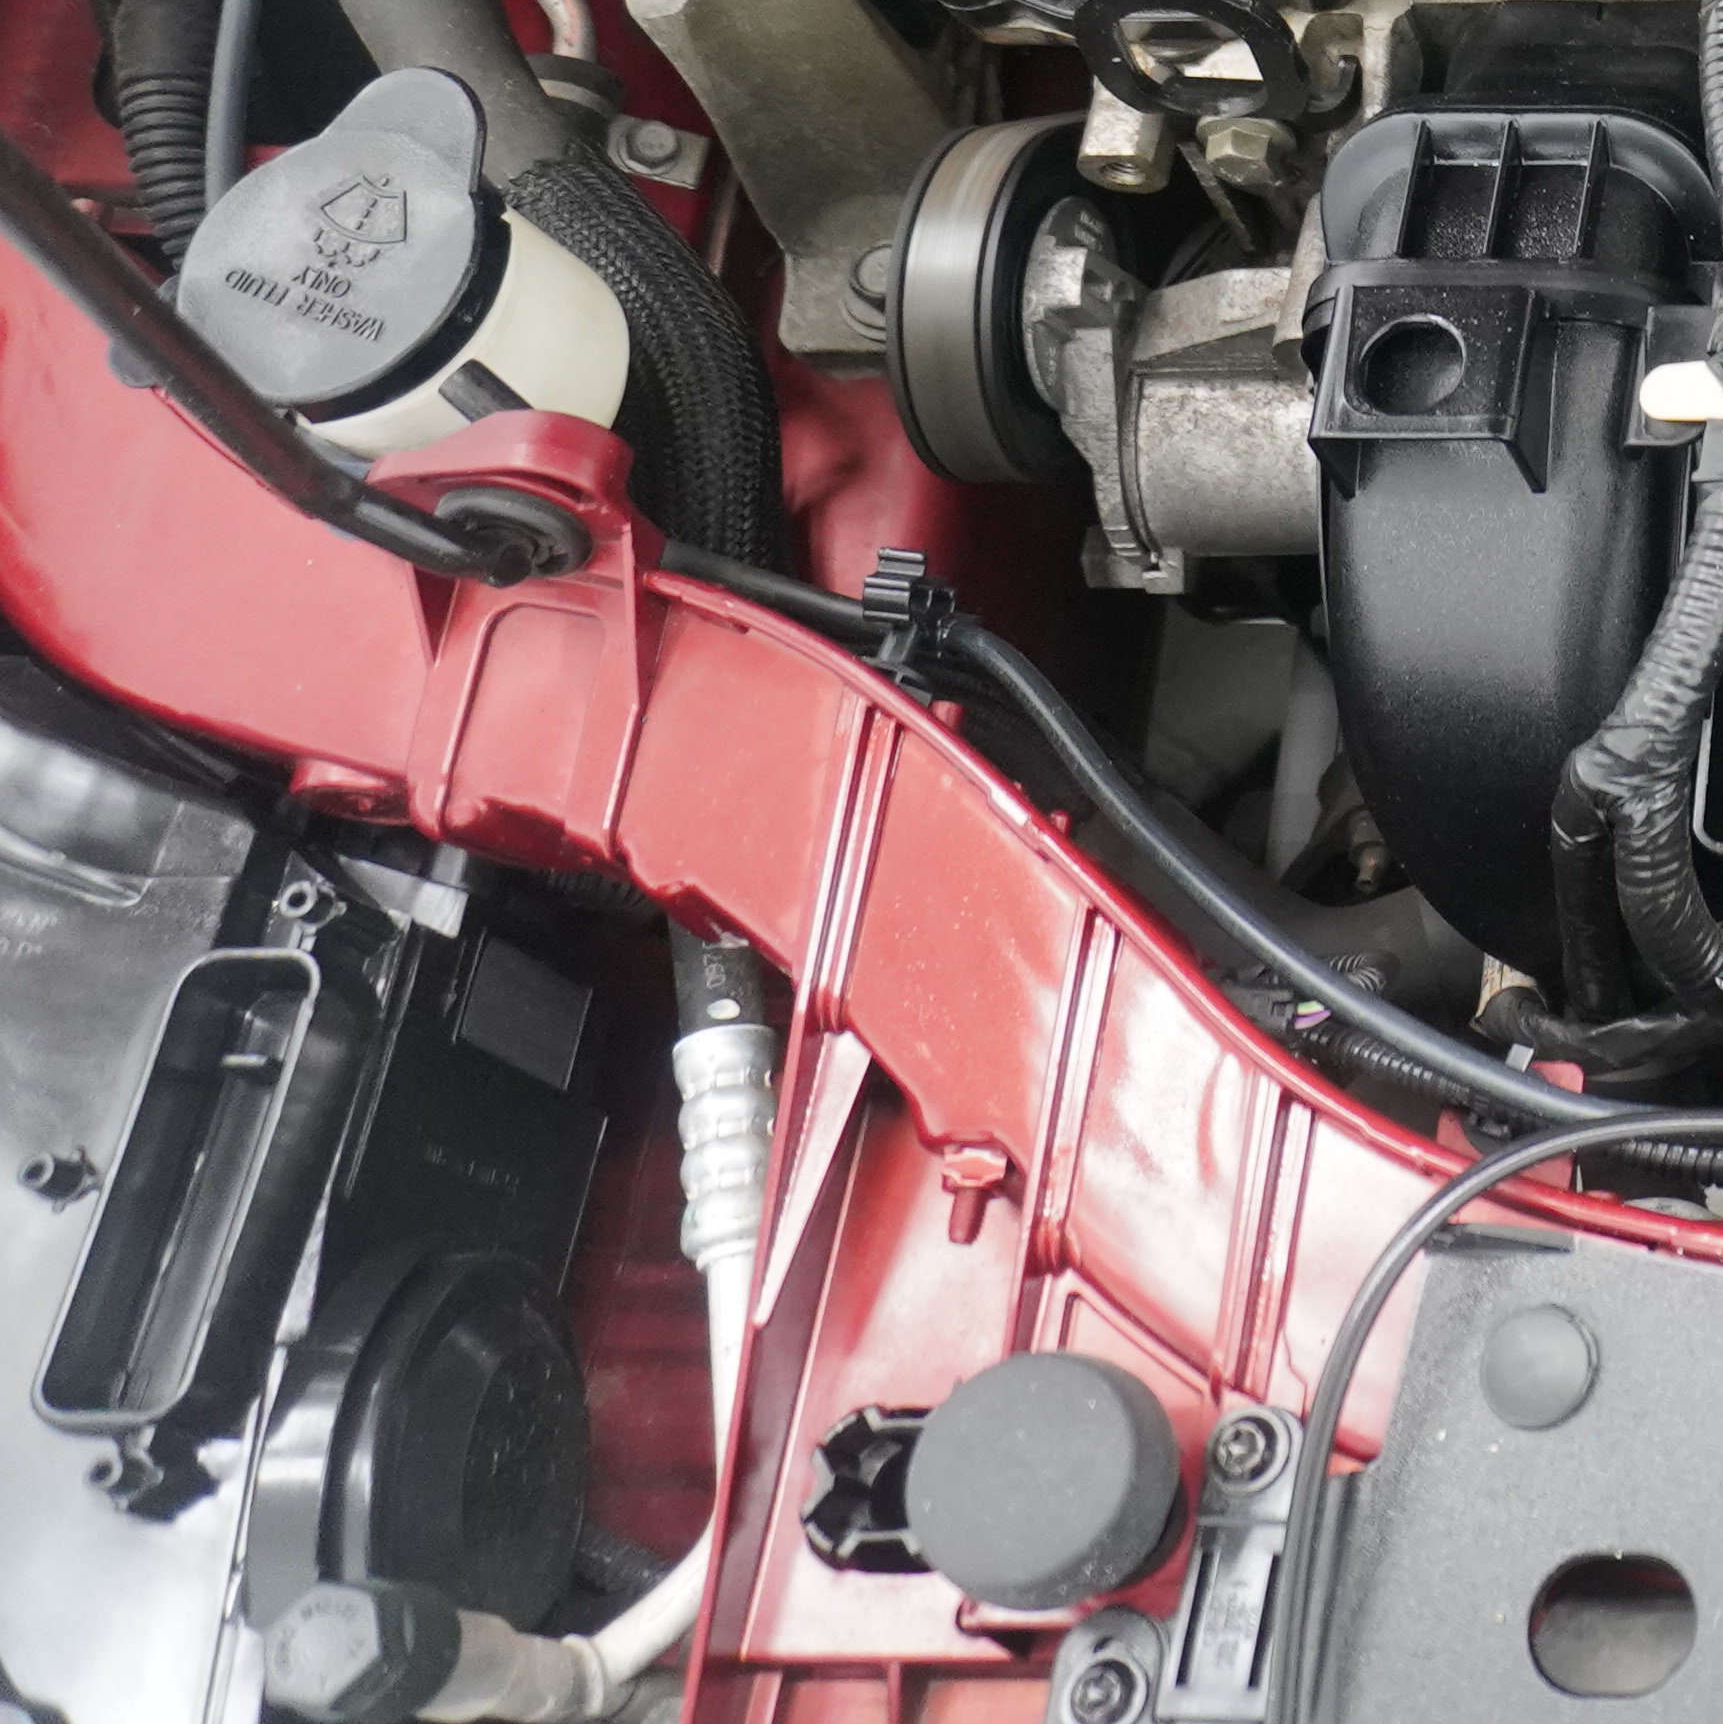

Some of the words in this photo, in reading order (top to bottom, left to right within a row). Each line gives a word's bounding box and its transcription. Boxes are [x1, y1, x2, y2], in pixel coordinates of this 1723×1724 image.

[224, 267, 291, 308] FLUID
[291, 267, 352, 299] ONLY
[296, 296, 386, 342] WASHER
